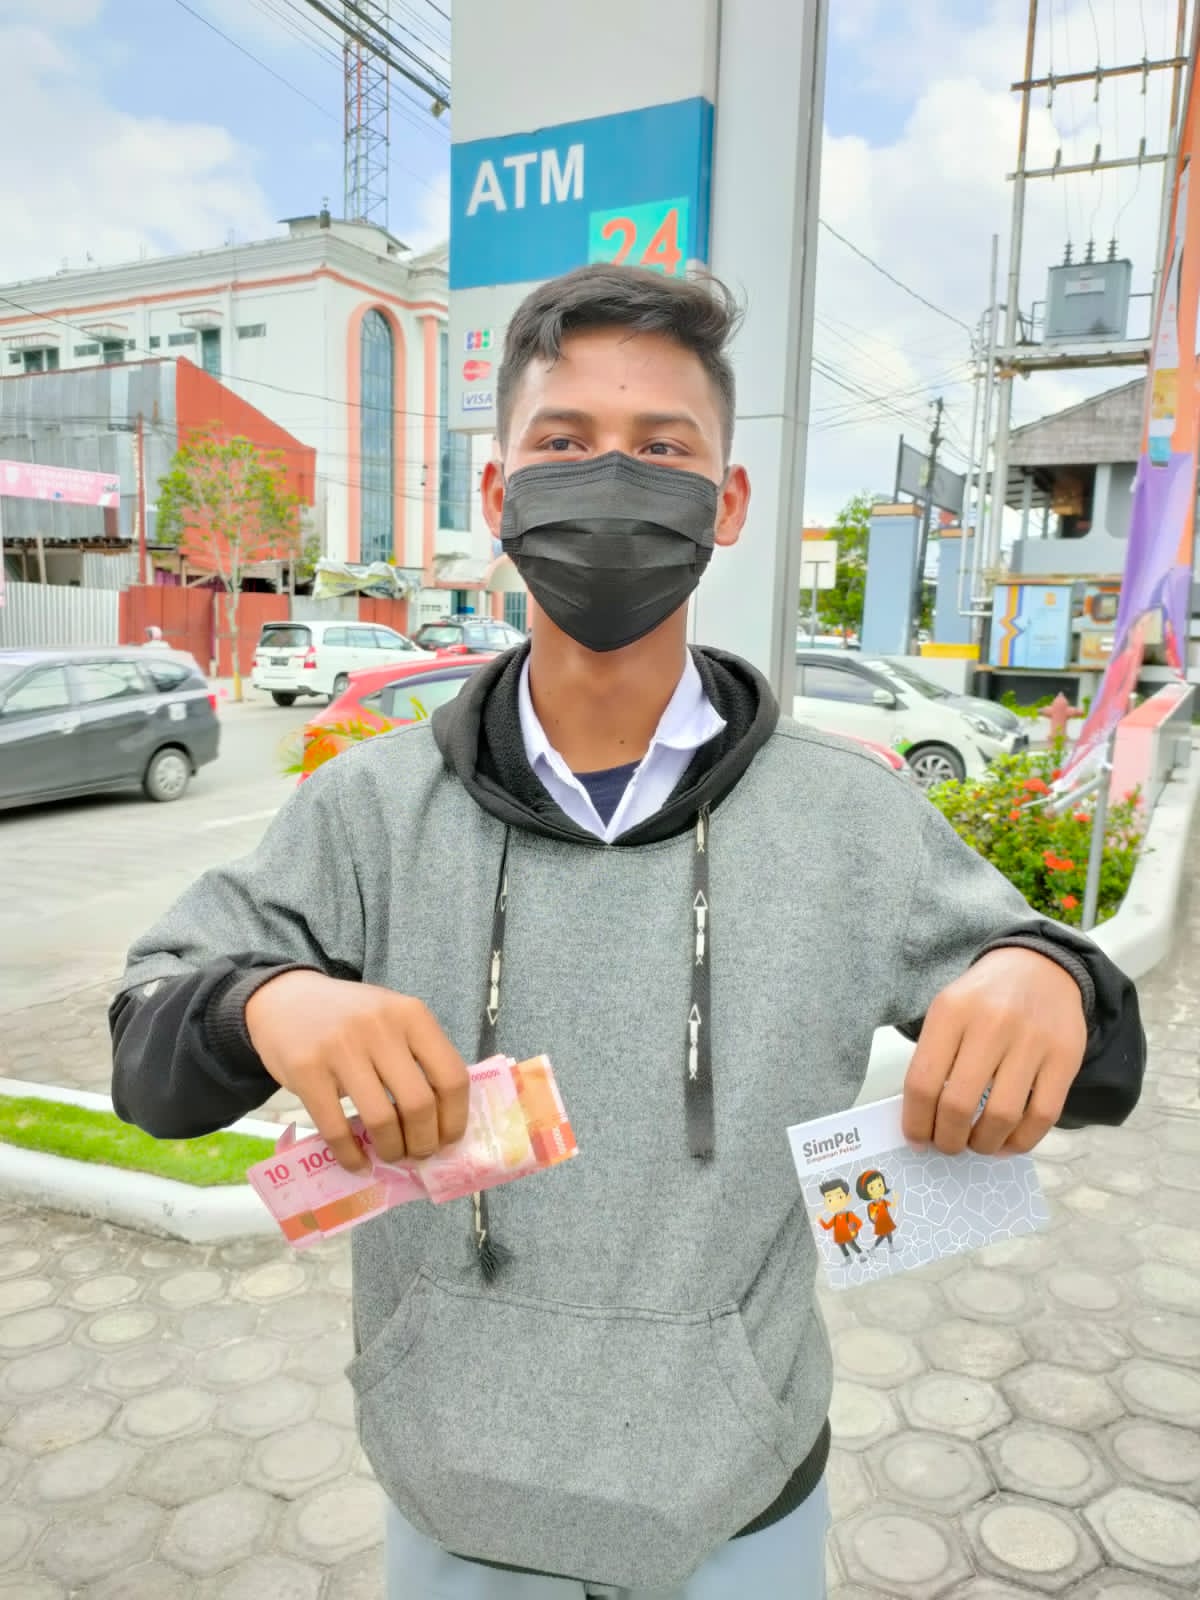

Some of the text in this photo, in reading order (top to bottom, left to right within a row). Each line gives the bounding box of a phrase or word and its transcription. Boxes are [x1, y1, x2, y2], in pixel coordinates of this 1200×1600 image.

[466, 143, 585, 217] ATM
[602, 208, 682, 275] 24
[466, 393, 493, 406] VISA
[802, 1127, 861, 1158] SimPel
